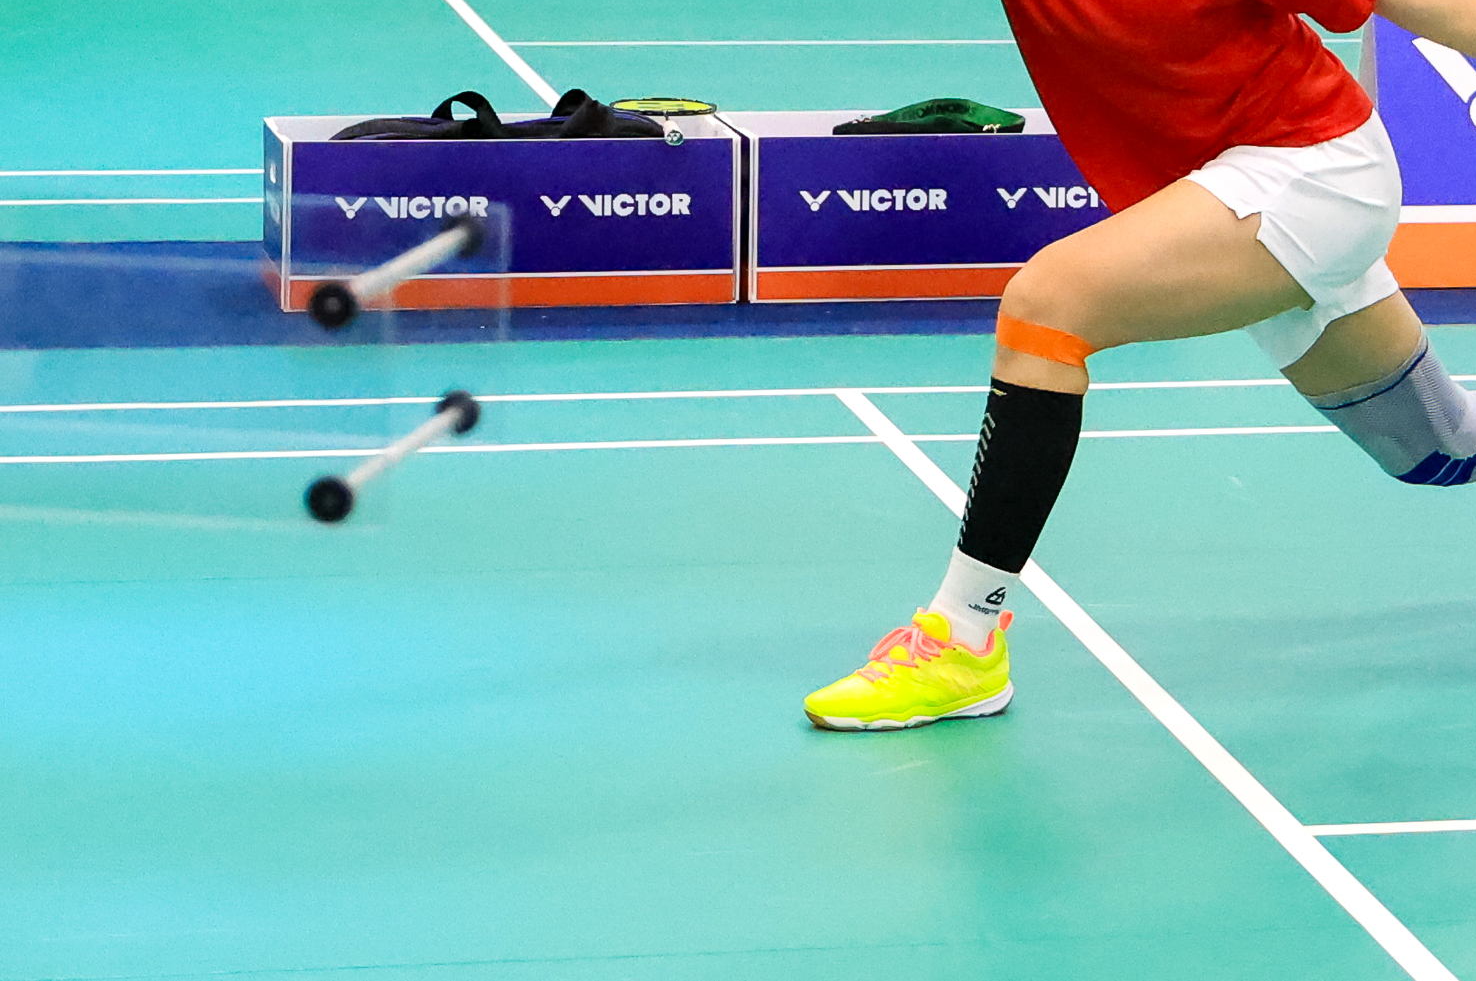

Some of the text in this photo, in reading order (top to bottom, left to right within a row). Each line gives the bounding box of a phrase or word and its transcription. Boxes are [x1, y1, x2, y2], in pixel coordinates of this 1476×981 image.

[374, 195, 489, 219] VICTOR
[578, 193, 692, 217] VICTOR
[836, 188, 948, 211] VICTOR
[1032, 186, 1107, 209] VICT
